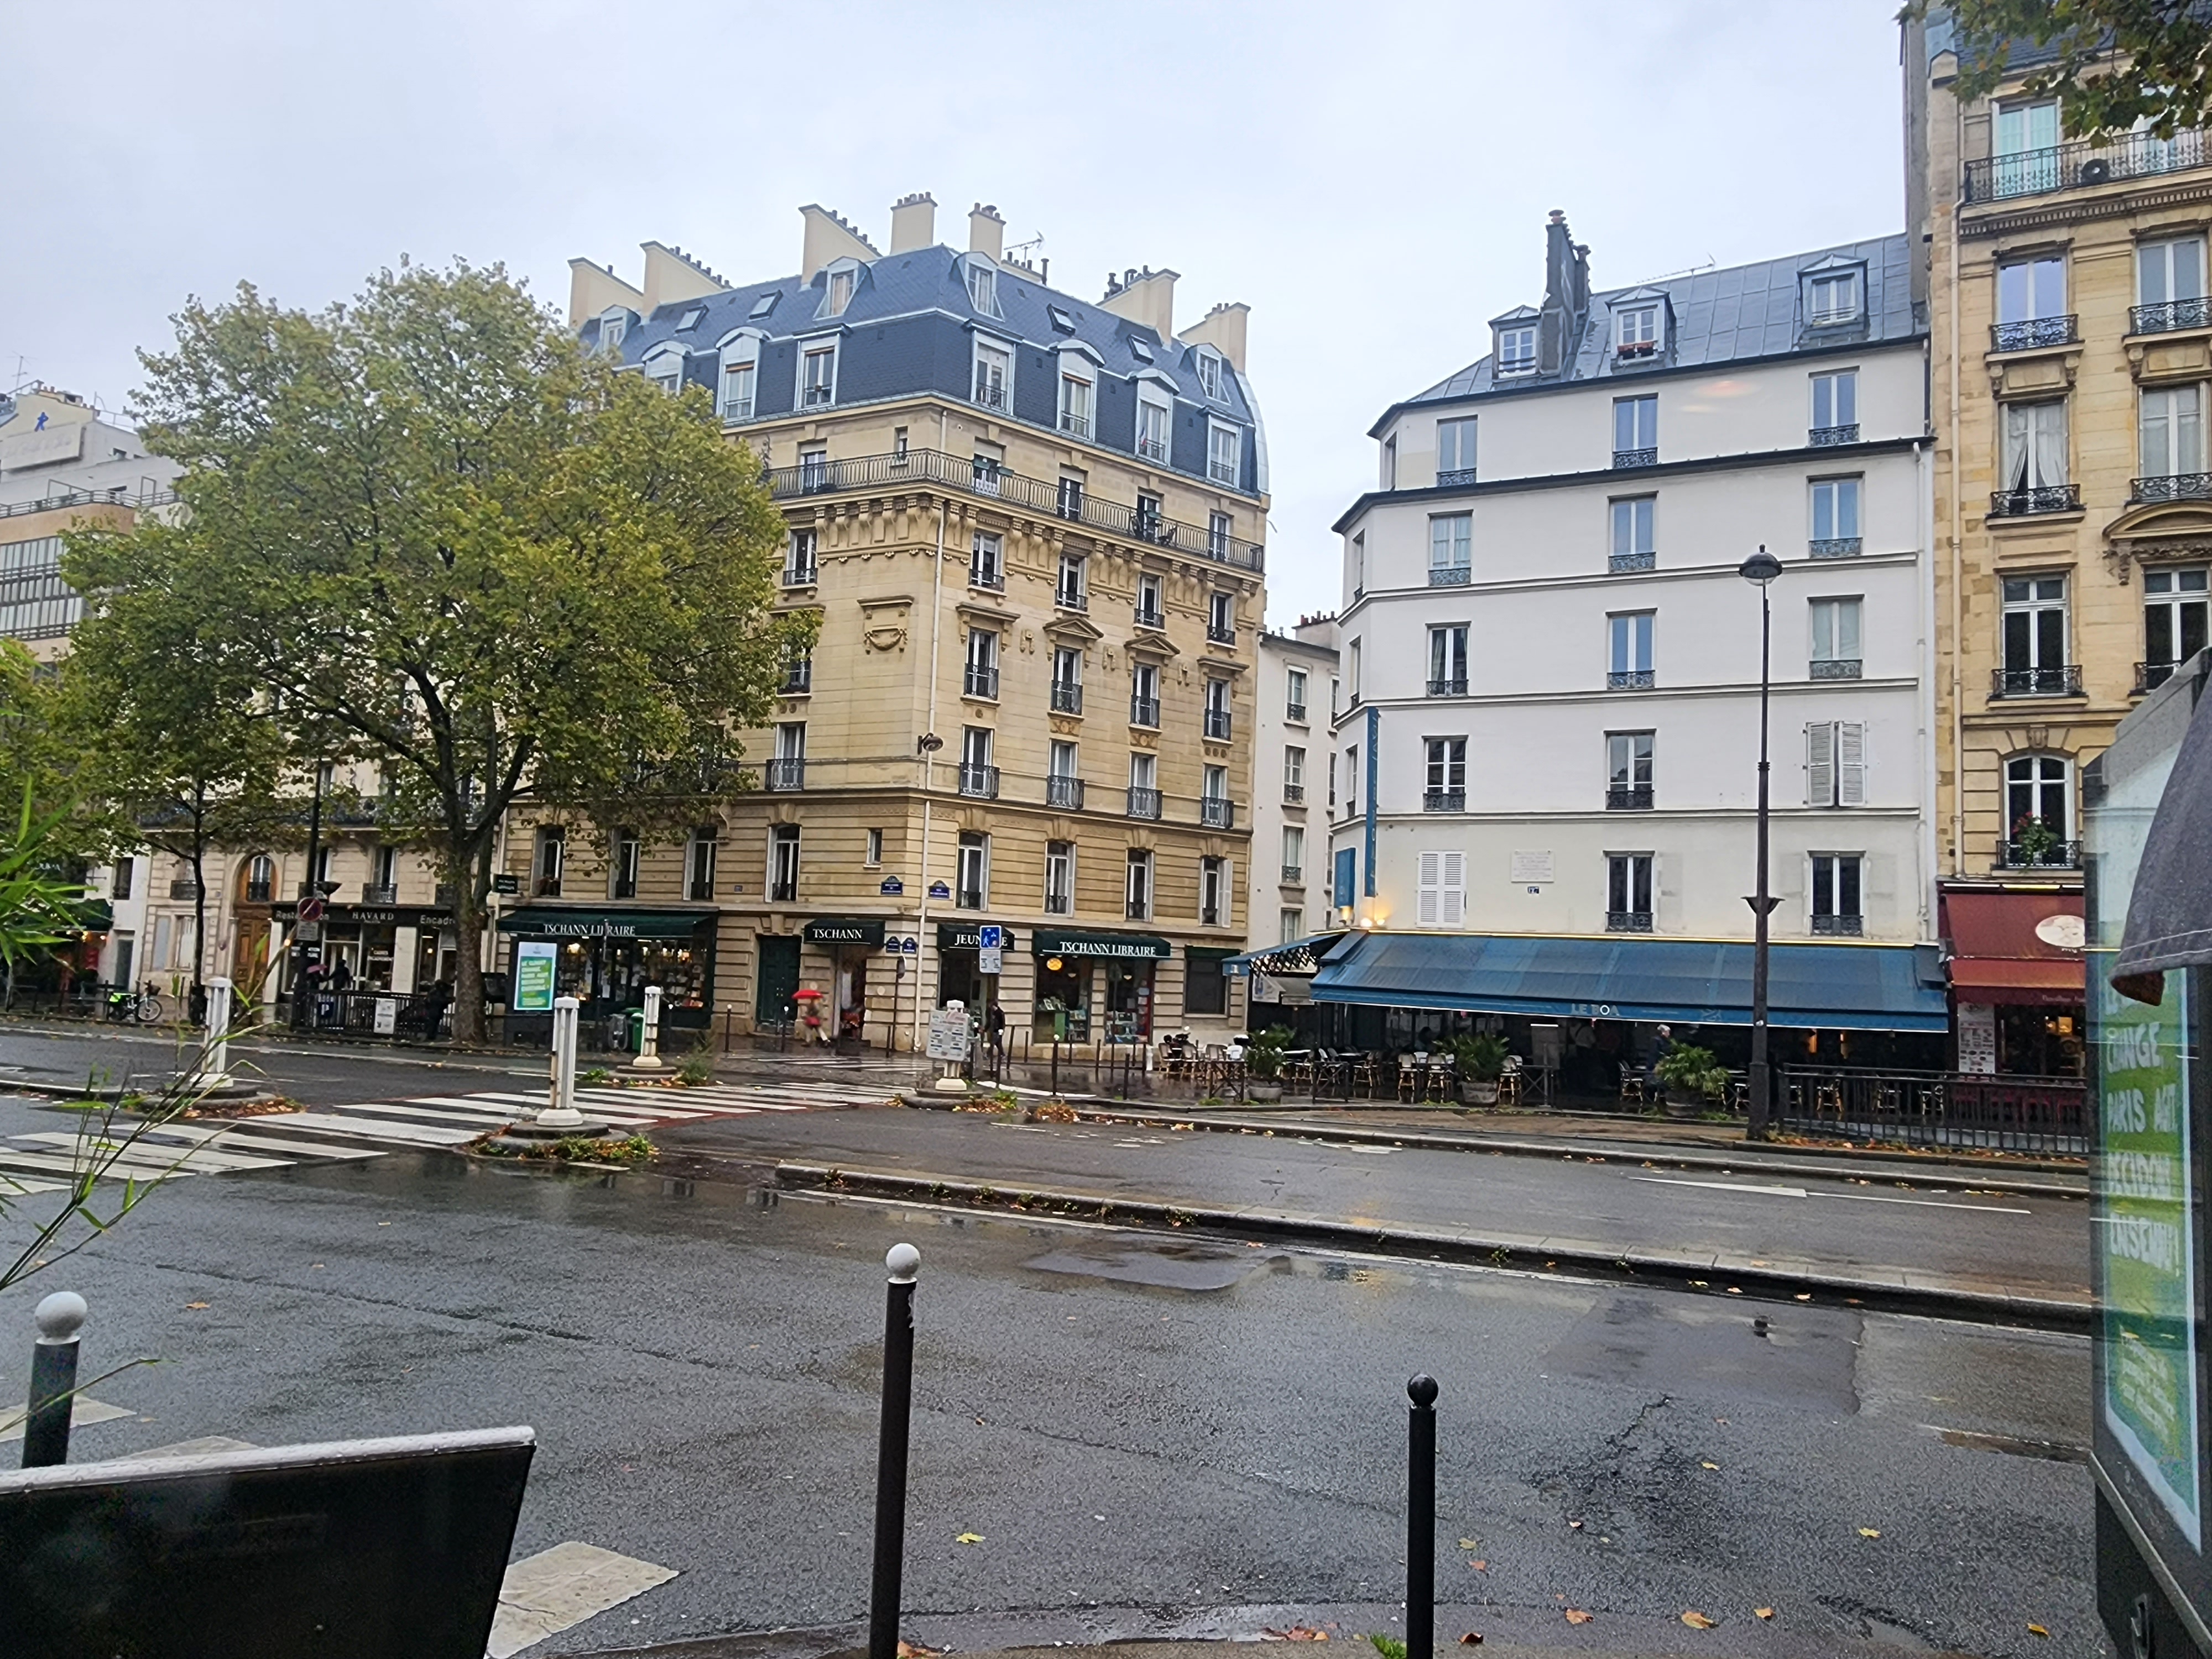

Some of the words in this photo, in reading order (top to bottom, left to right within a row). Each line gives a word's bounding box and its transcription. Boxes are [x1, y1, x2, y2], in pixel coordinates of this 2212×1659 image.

[352, 911, 394, 921] HAVARD
[544, 924, 588, 935] TSCHANN
[813, 928, 863, 939] TSCHANN
[1060, 941, 1109, 954] TSCHANN
[1112, 943, 1156, 956] LIBRAIRE
[321, 1004, 329, 1015] P
[1571, 1003, 1588, 1015] LE
[1590, 1004, 1620, 1016] BOA
[2107, 1088, 2147, 1133] PARIS
